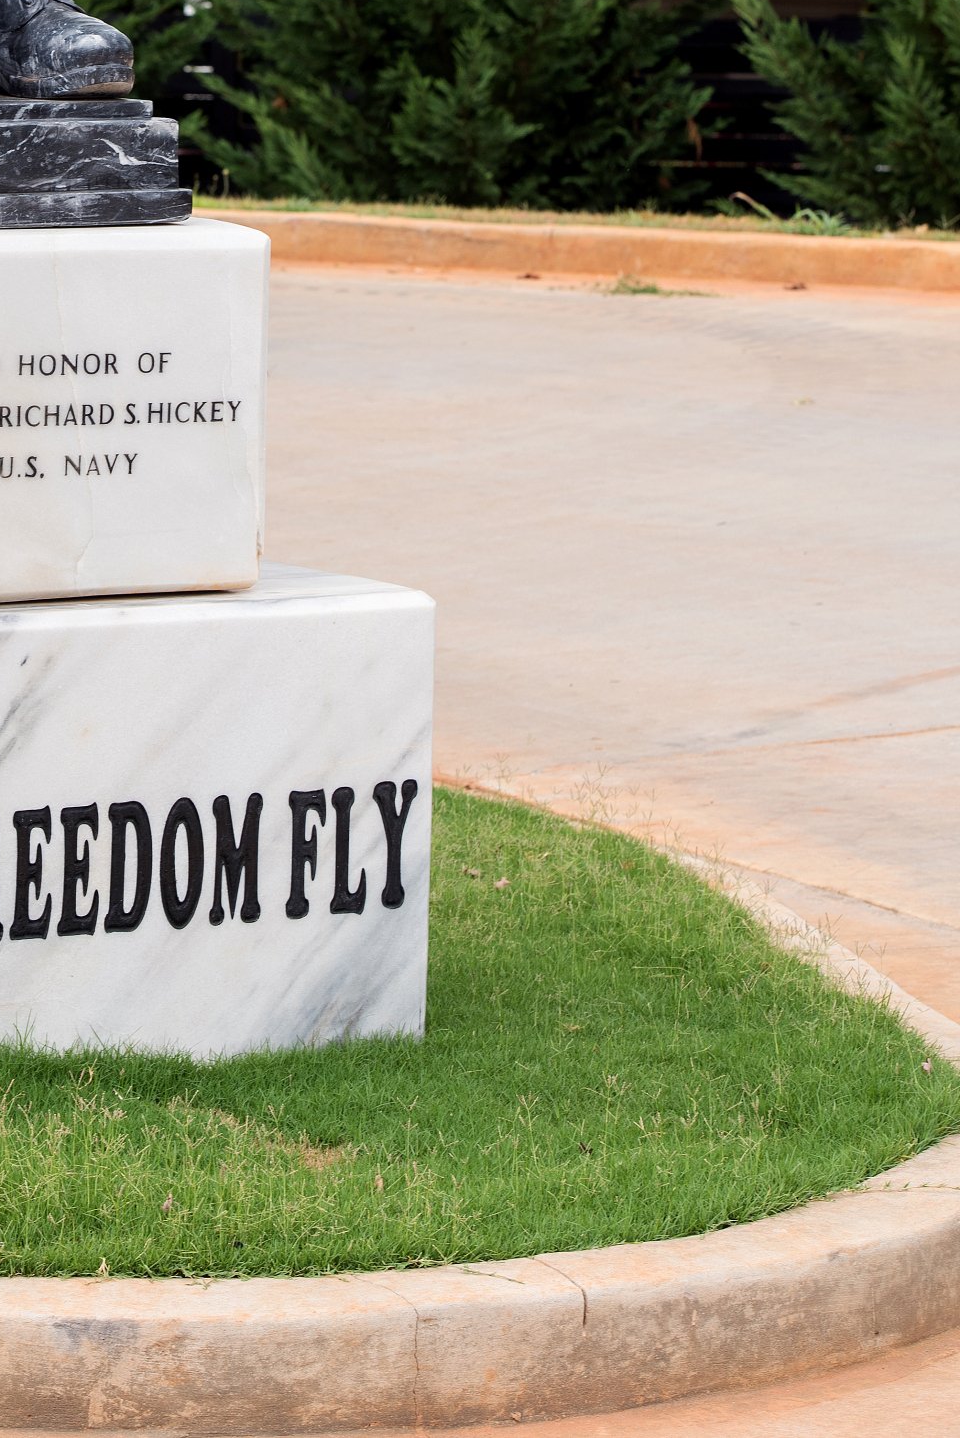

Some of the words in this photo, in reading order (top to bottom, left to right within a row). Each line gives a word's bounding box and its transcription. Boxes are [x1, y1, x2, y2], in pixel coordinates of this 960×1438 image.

[18, 353, 119, 376] HONOR
[138, 352, 172, 374] OF
[123, 403, 141, 425] S.
[147, 401, 242, 424] HICKEY
[0, 456, 45, 478] U.S.
[64, 453, 138, 476] NAVY
[285, 778, 418, 920] FLY
